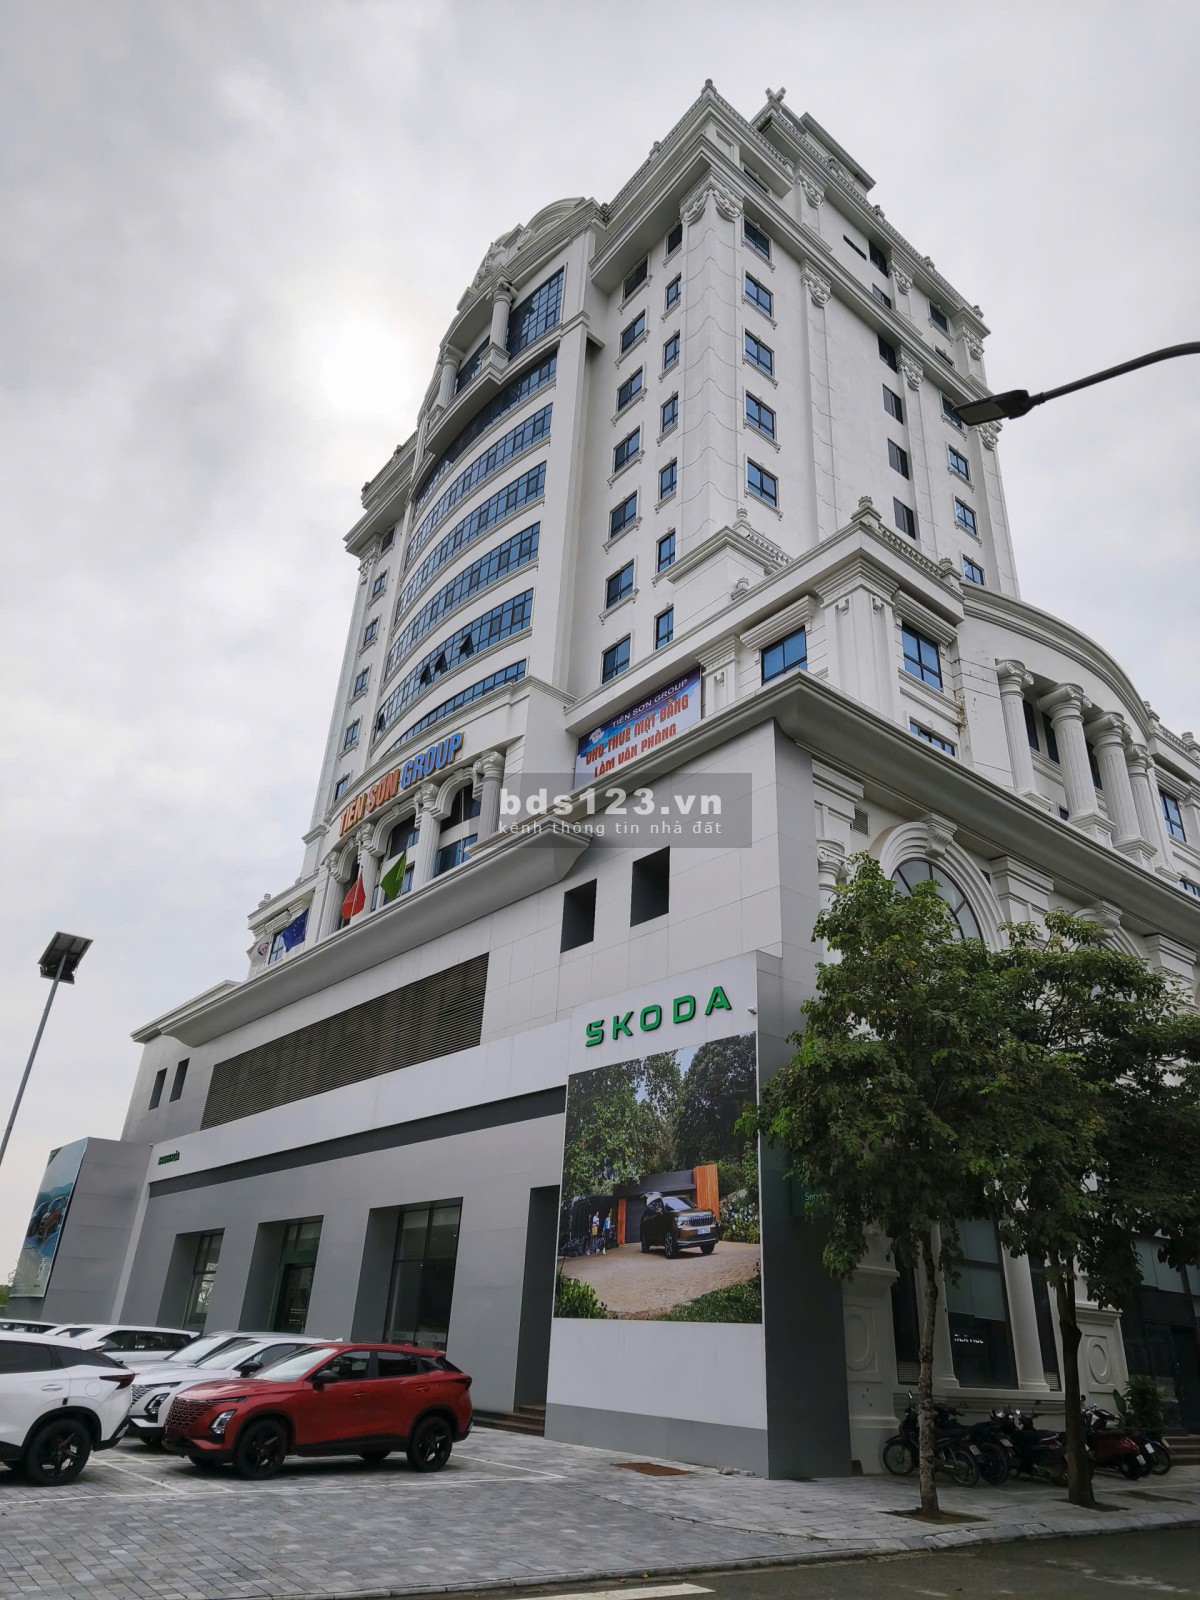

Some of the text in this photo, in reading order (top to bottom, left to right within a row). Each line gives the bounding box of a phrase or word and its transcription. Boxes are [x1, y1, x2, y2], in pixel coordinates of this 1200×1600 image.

[654, 679, 688, 703] GROUP
[400, 731, 465, 790] GROUP
[594, 756, 615, 778] LÀM
[640, 723, 677, 752] PHÒNG
[607, 725, 631, 752] THUÊ
[585, 985, 732, 1047] SKODA
